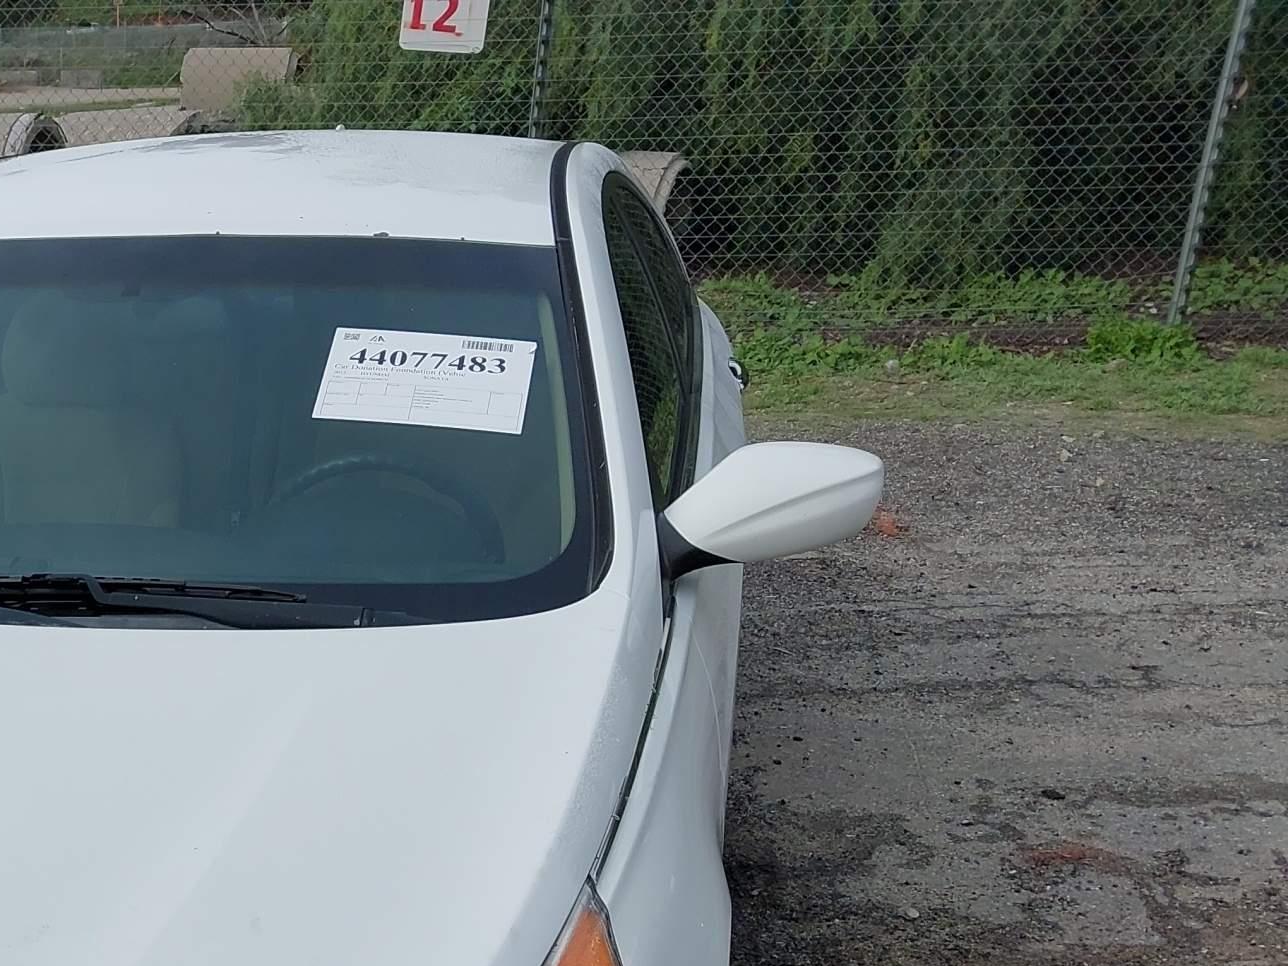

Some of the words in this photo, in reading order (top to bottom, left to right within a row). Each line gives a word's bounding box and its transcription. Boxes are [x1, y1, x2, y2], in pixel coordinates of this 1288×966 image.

[409, 0, 460, 33] 12
[349, 348, 506, 374] 44077483
[351, 364, 389, 372] Donation
